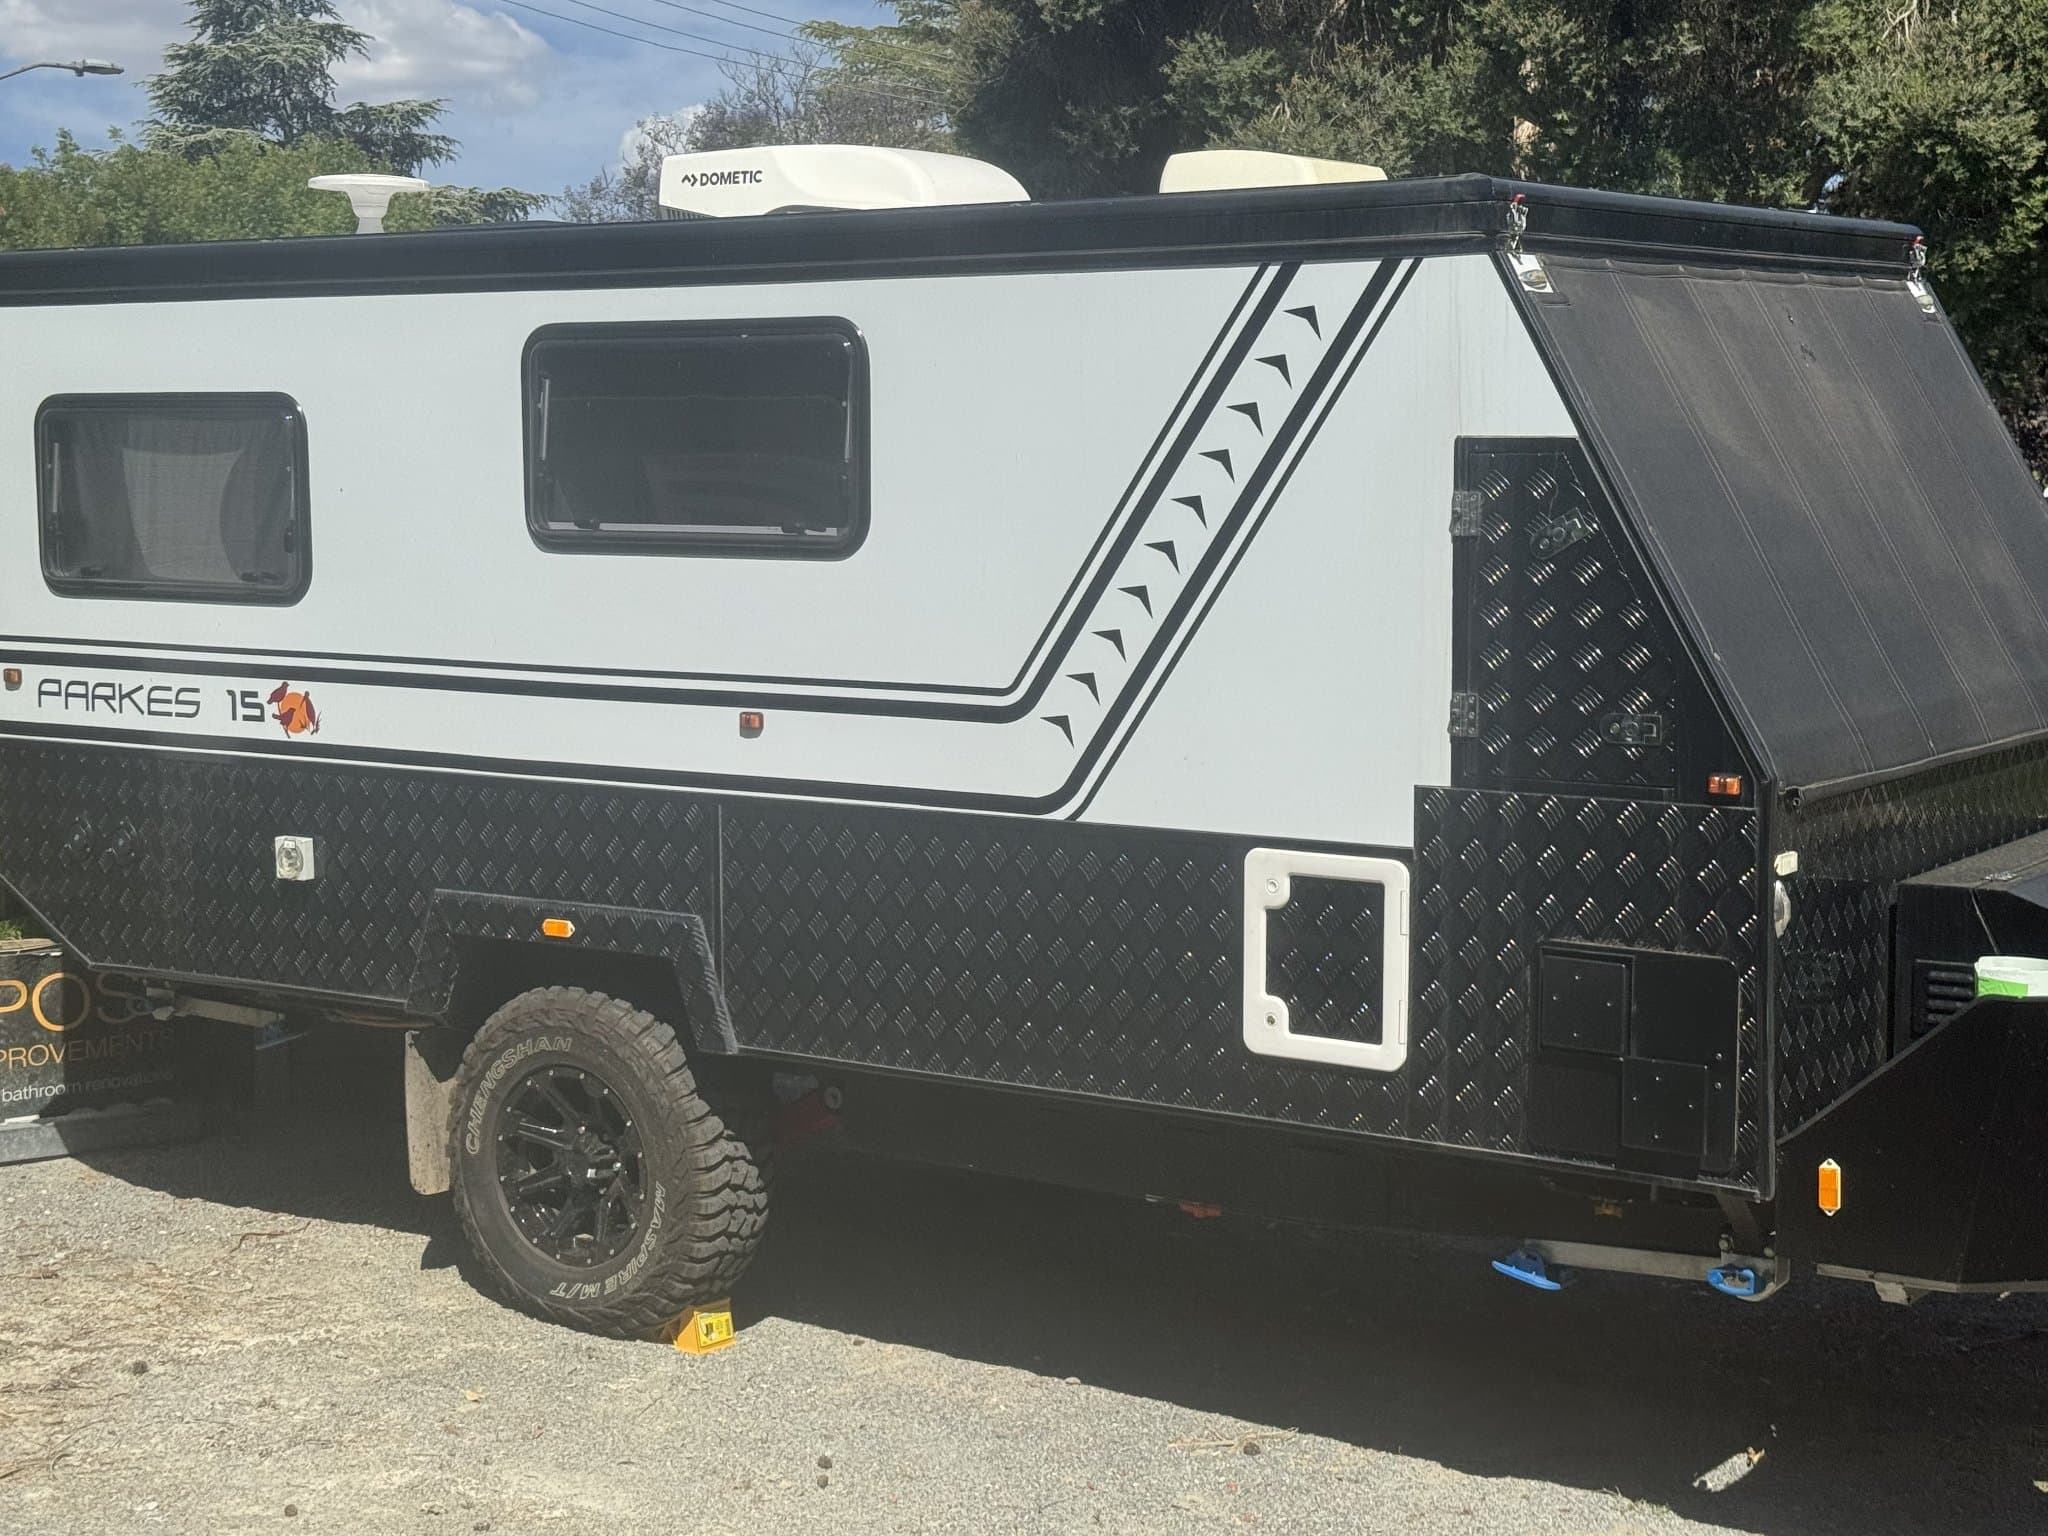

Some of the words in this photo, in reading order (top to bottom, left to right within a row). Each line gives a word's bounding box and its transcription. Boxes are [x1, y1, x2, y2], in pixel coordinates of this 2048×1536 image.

[700, 170, 763, 186] DOMETIC
[38, 678, 201, 719] PARKES
[226, 689, 265, 722] 15
[2, 1080, 83, 1102] bathroom
[464, 1036, 573, 1155] CHENGSHAN
[550, 1282, 601, 1299] M/T
